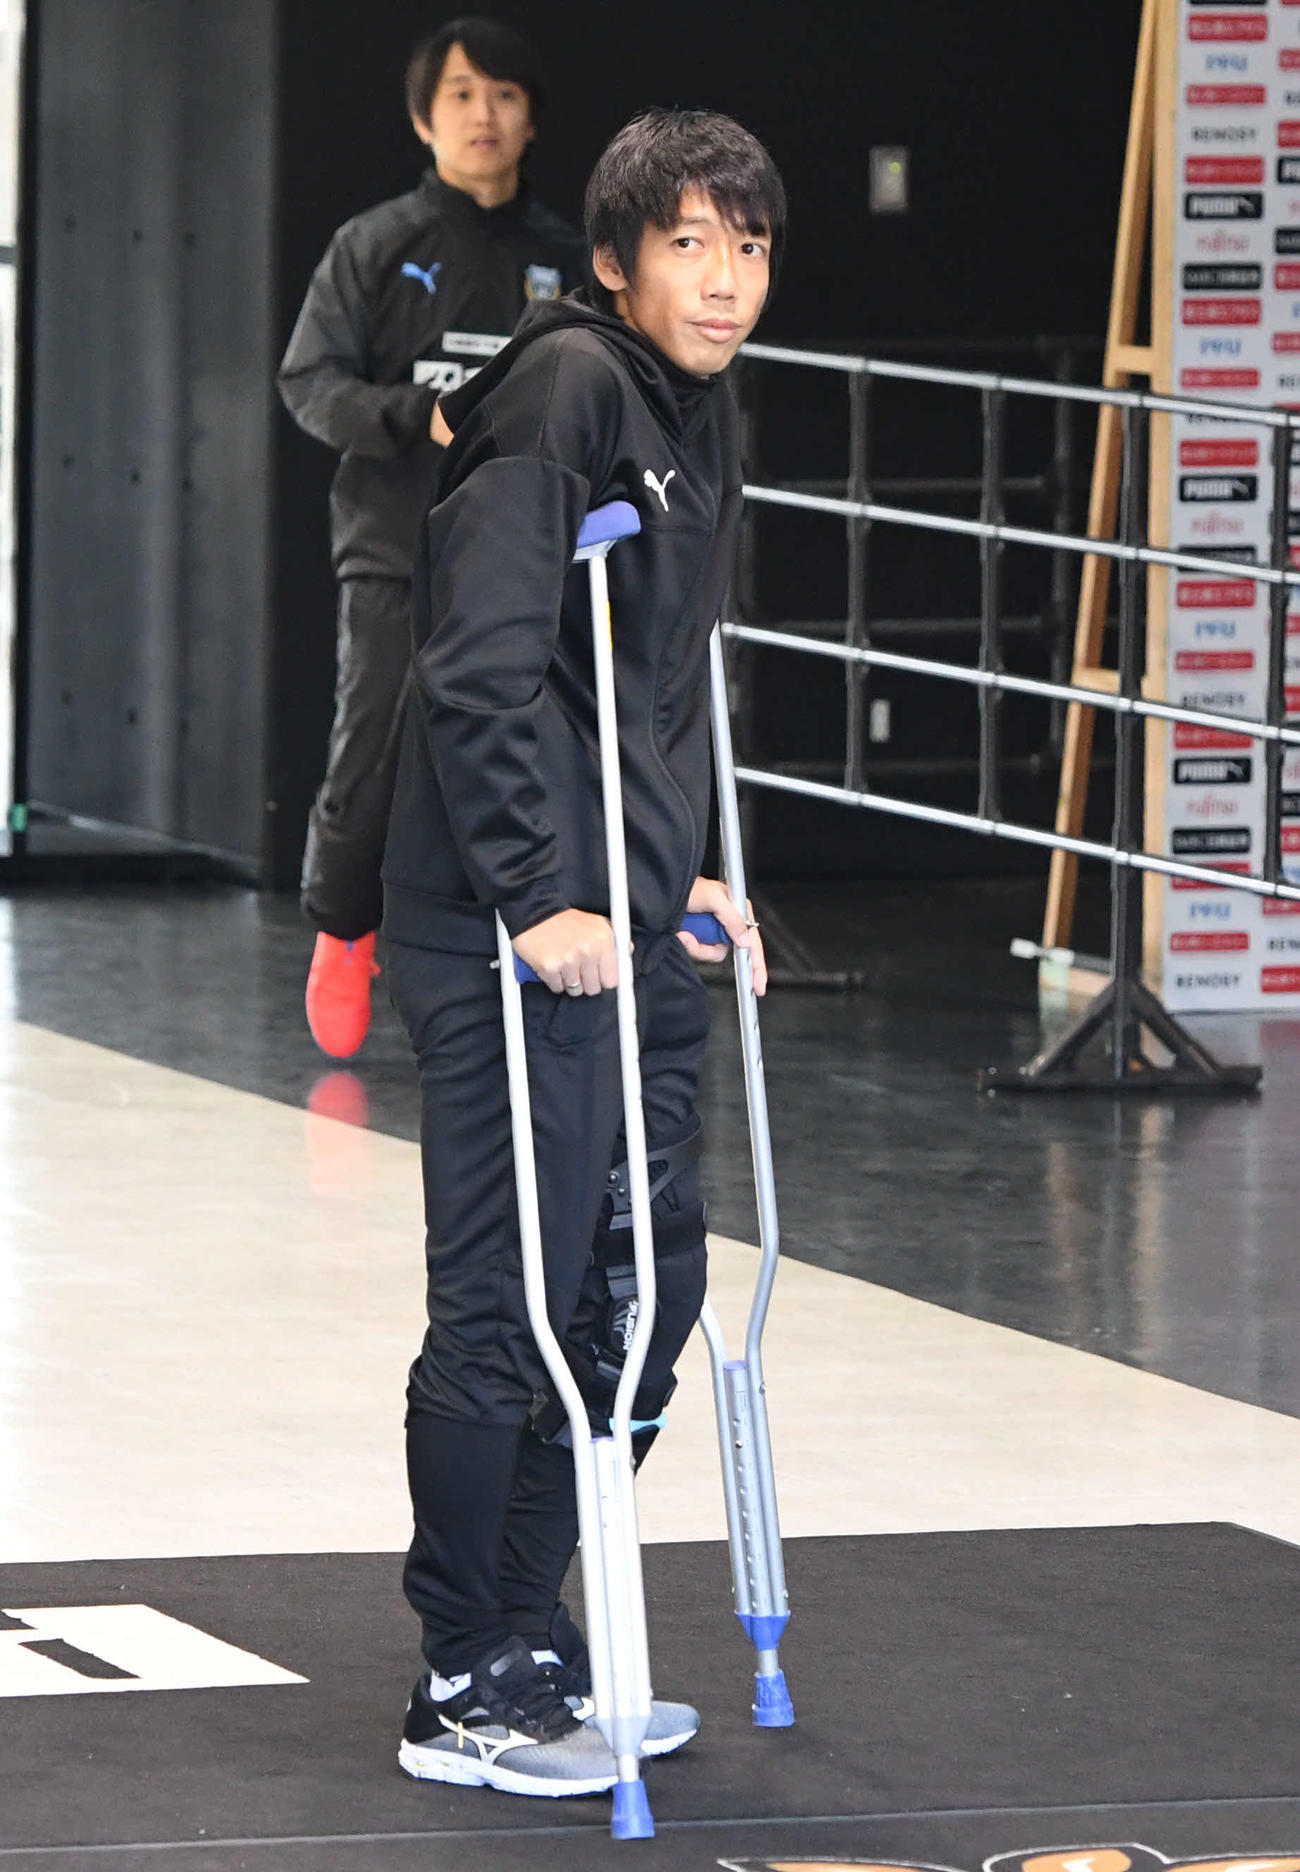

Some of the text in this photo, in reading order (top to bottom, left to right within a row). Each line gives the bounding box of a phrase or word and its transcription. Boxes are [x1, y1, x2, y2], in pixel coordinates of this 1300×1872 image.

[1191, 197, 1239, 215] PUMA
[1184, 480, 1233, 498] PUMA
[1178, 760, 1228, 779] PUMA
[623, 1304, 638, 1351] FUSION
